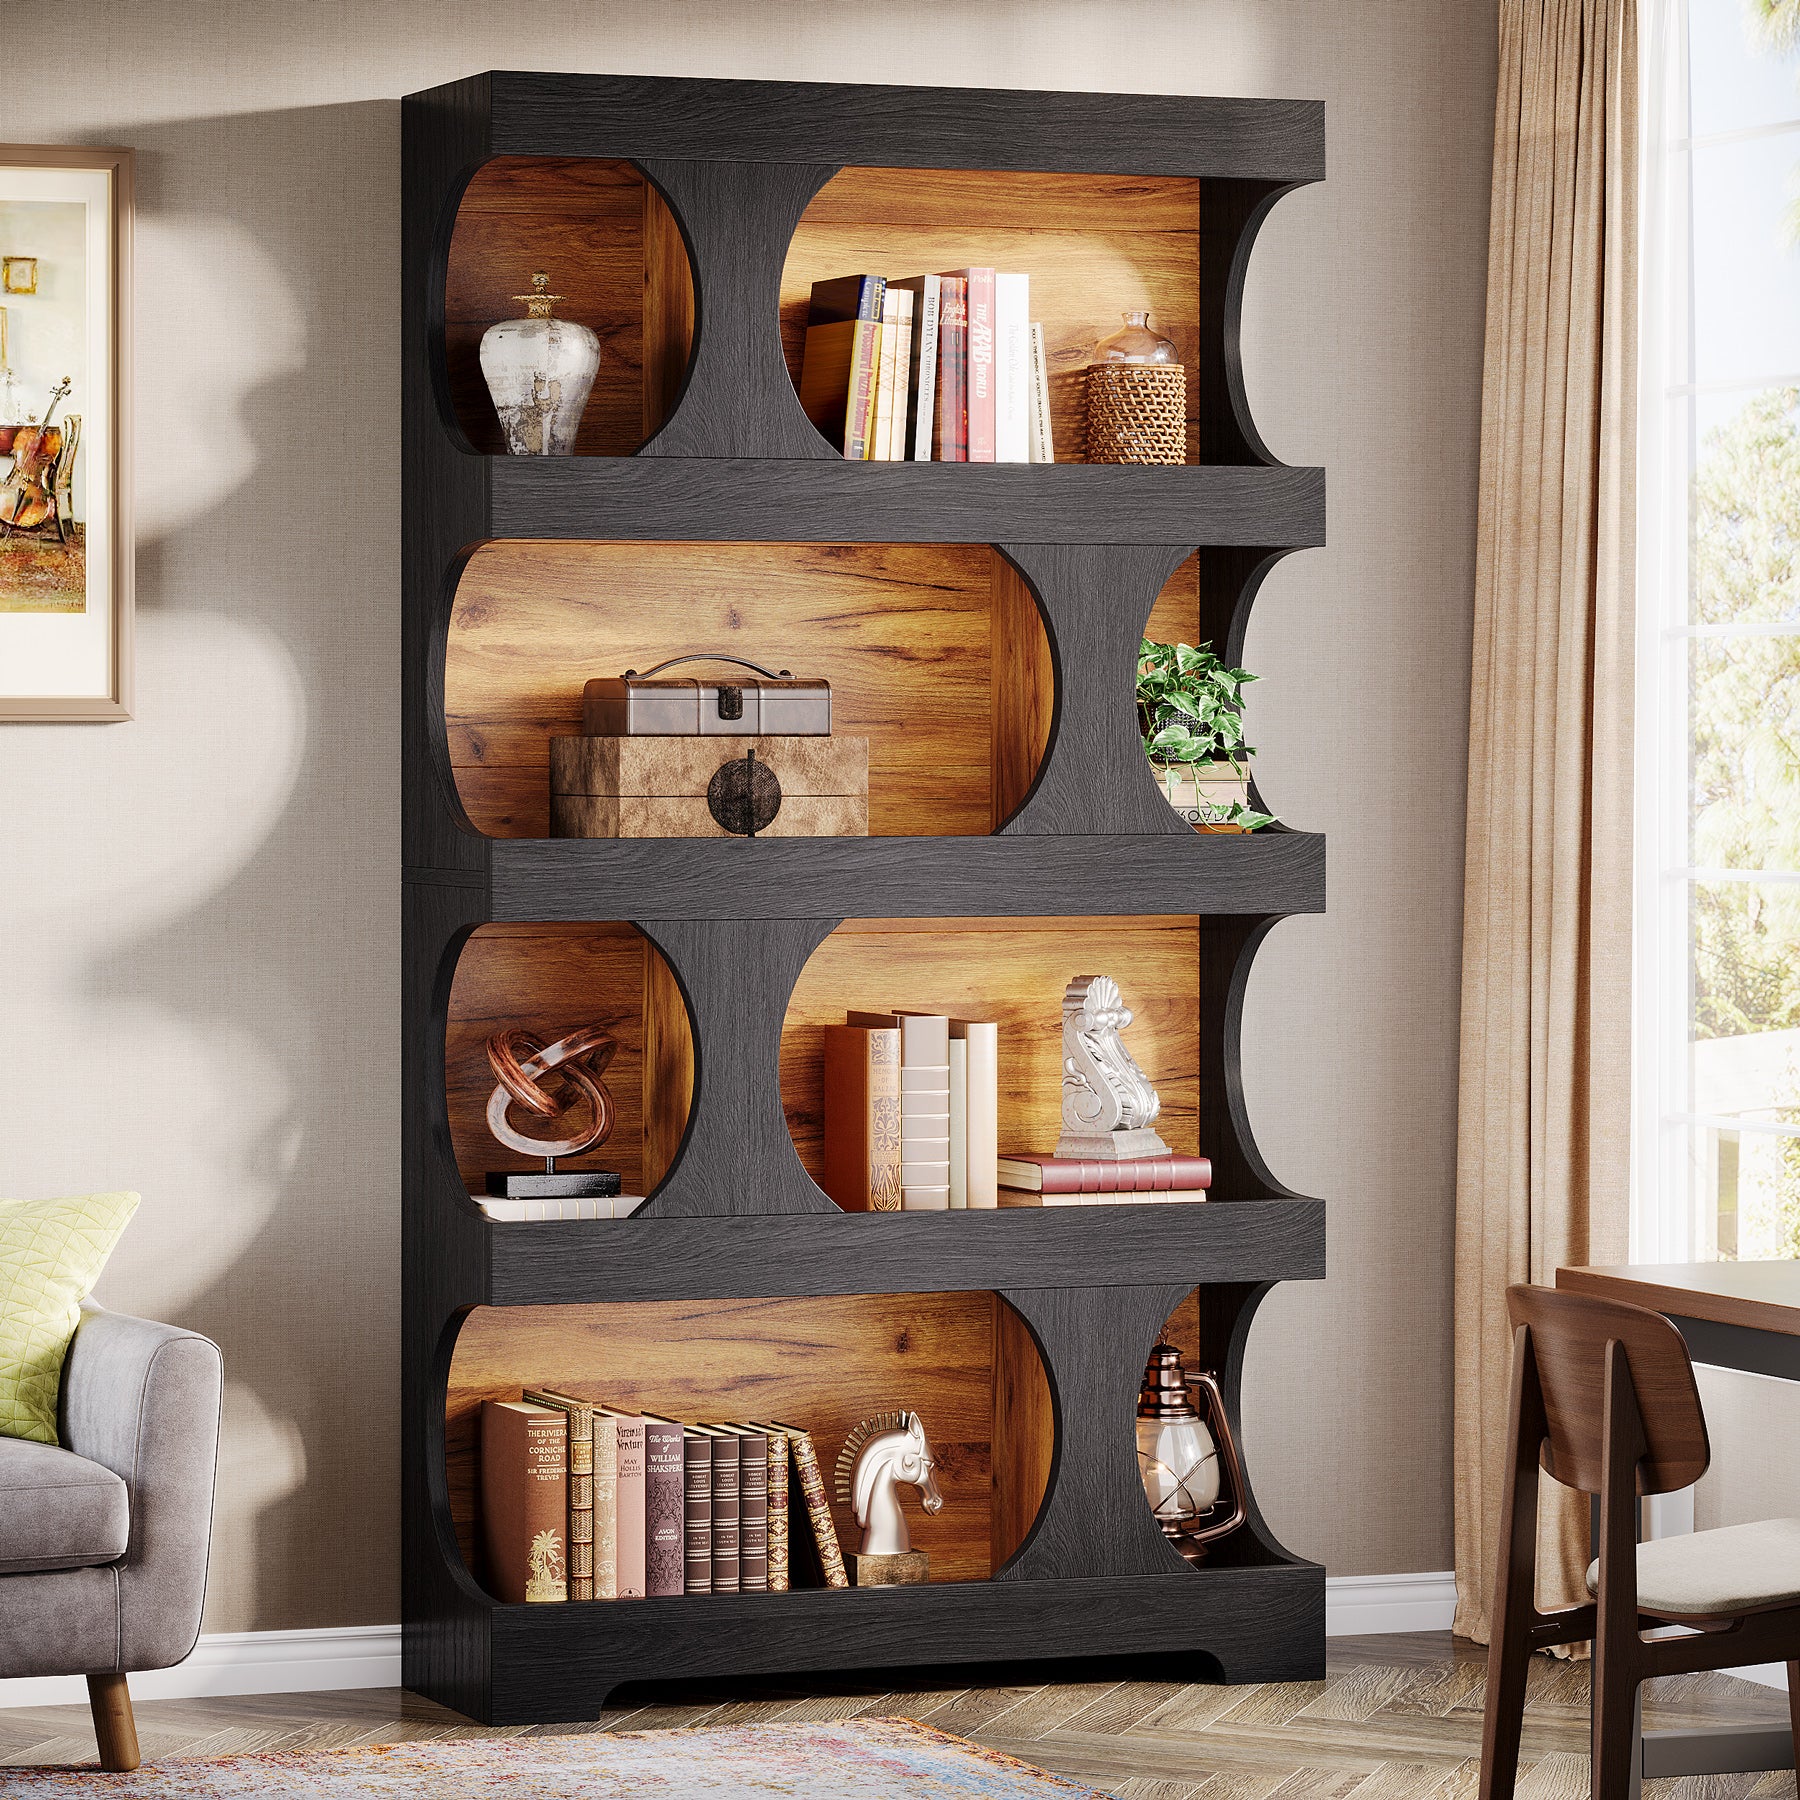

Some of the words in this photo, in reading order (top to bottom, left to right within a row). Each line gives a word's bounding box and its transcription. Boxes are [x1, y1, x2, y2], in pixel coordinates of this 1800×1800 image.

[861, 281, 872, 318] Complete
[927, 297, 935, 316] BOB
[976, 303, 987, 323] THE
[925, 319, 934, 352] DYLAN
[972, 319, 992, 364] ARAB
[860, 323, 877, 369] Crossword
[857, 371, 873, 397] Puzzle
[976, 364, 987, 399] WORLD
[852, 398, 870, 439] Dictionary
[528, 1430, 541, 1438] THE
[542, 1428, 568, 1437] RIVIERA
[649, 1435, 661, 1443] The
[662, 1434, 682, 1443] Works
[529, 1446, 566, 1454] CORNICHE
[663, 1443, 671, 1453] of
[647, 1464, 683, 1473] SHAKSPERE
[650, 1454, 681, 1463] WILLIAM
